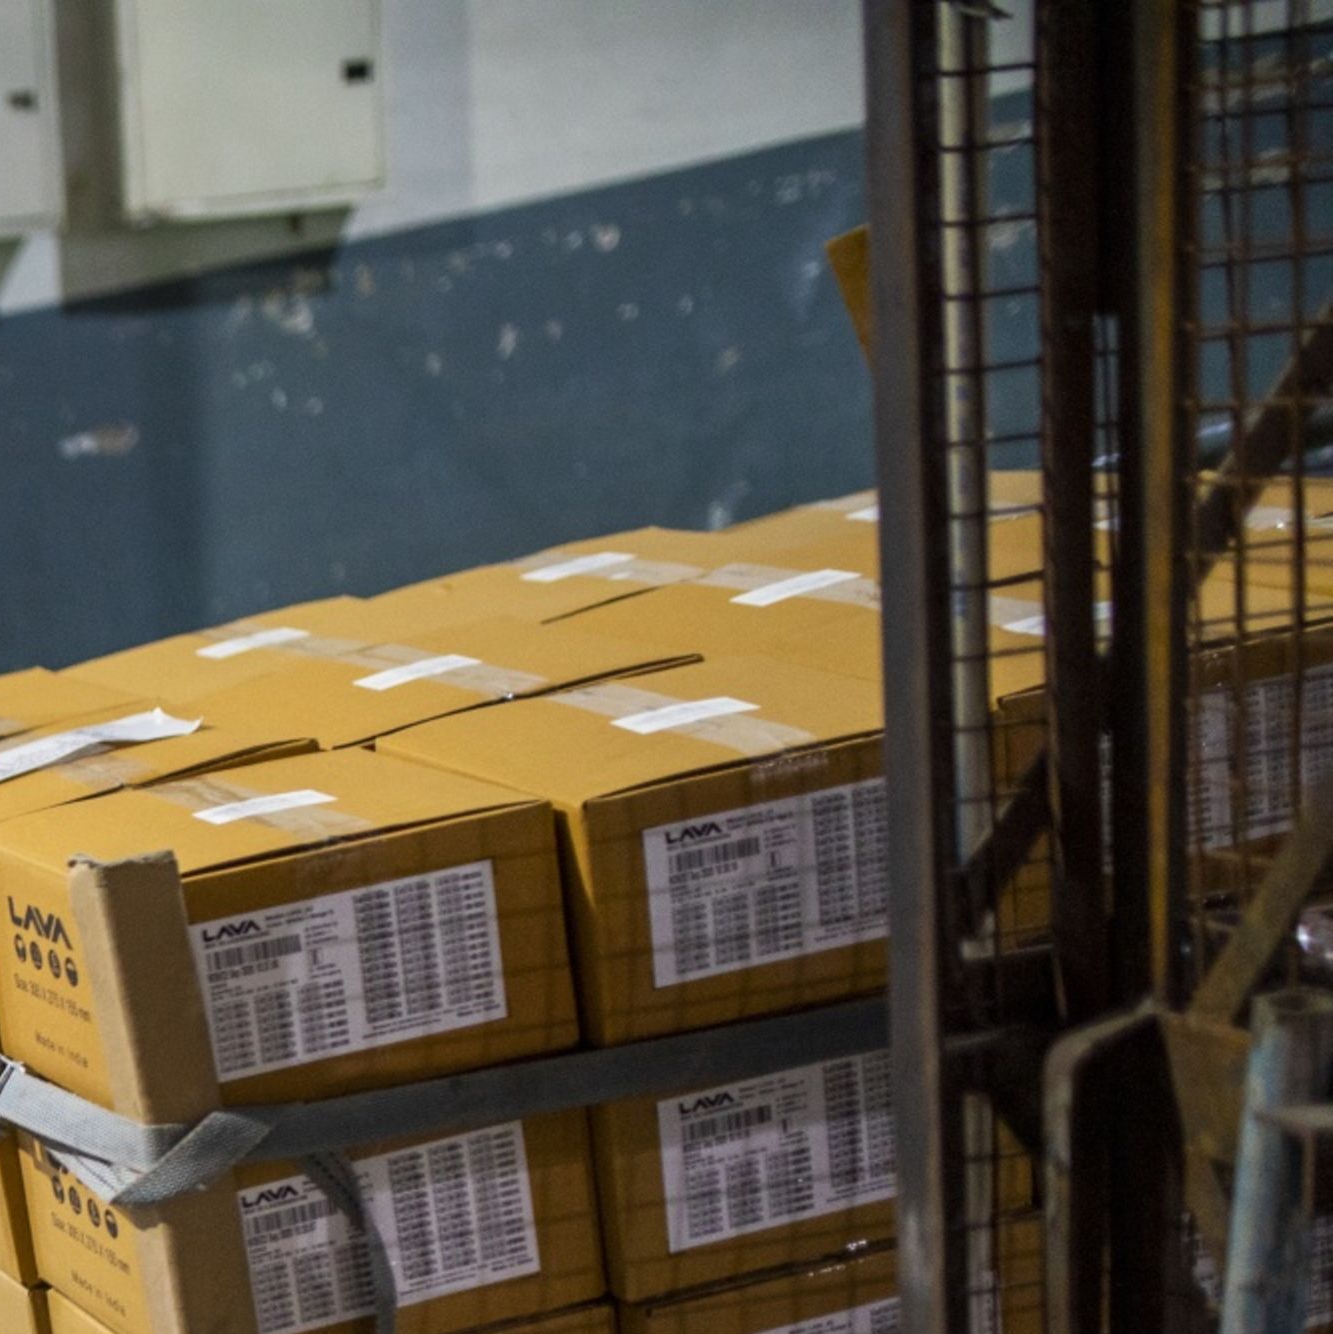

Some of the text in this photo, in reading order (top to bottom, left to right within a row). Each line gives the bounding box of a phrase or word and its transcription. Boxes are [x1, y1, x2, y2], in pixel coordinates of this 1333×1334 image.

[665, 822, 722, 844] LAVA
[8, 896, 73, 949] LAVA
[202, 919, 261, 942] LAVA
[678, 1092, 734, 1114] LAVA
[241, 1185, 299, 1208] LAVA
